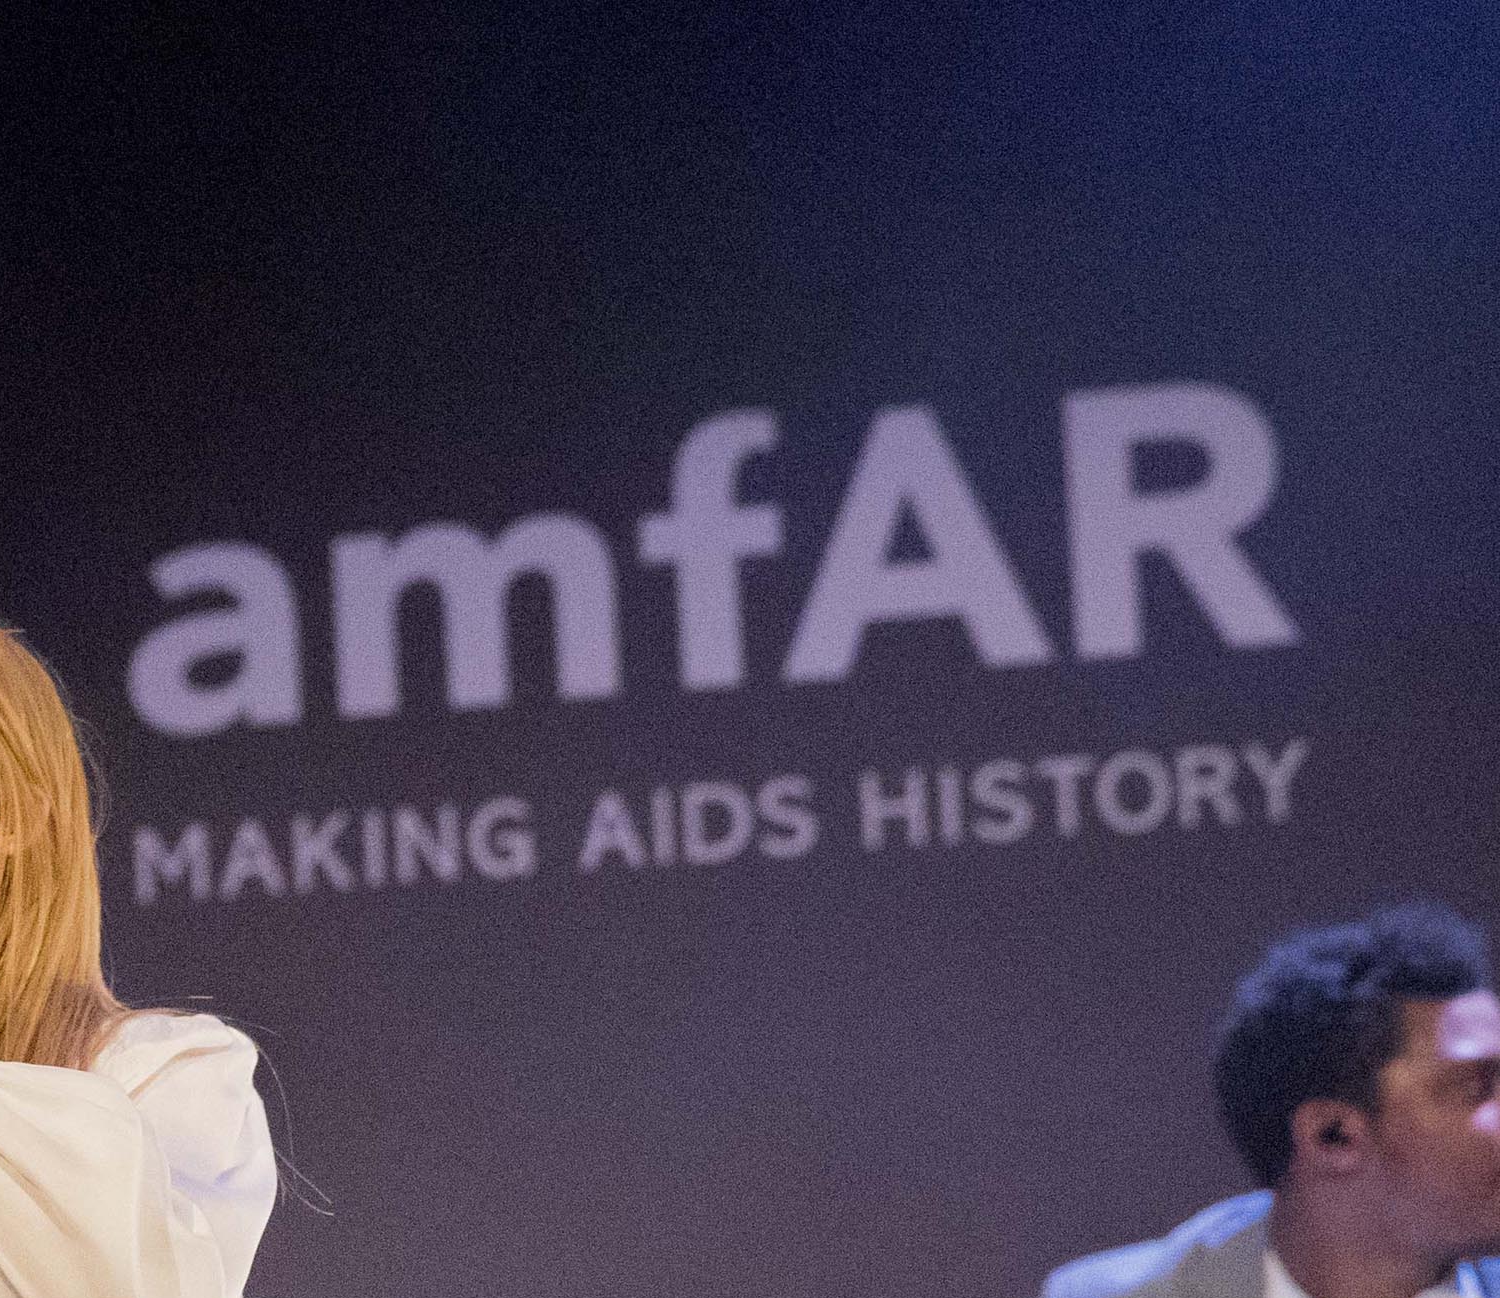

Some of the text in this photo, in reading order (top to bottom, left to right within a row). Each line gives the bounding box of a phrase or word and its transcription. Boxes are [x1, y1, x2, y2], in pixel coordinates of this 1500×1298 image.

[127, 382, 1301, 736] amfAR
[132, 739, 1308, 906] MAKING AIDS HISTORY
